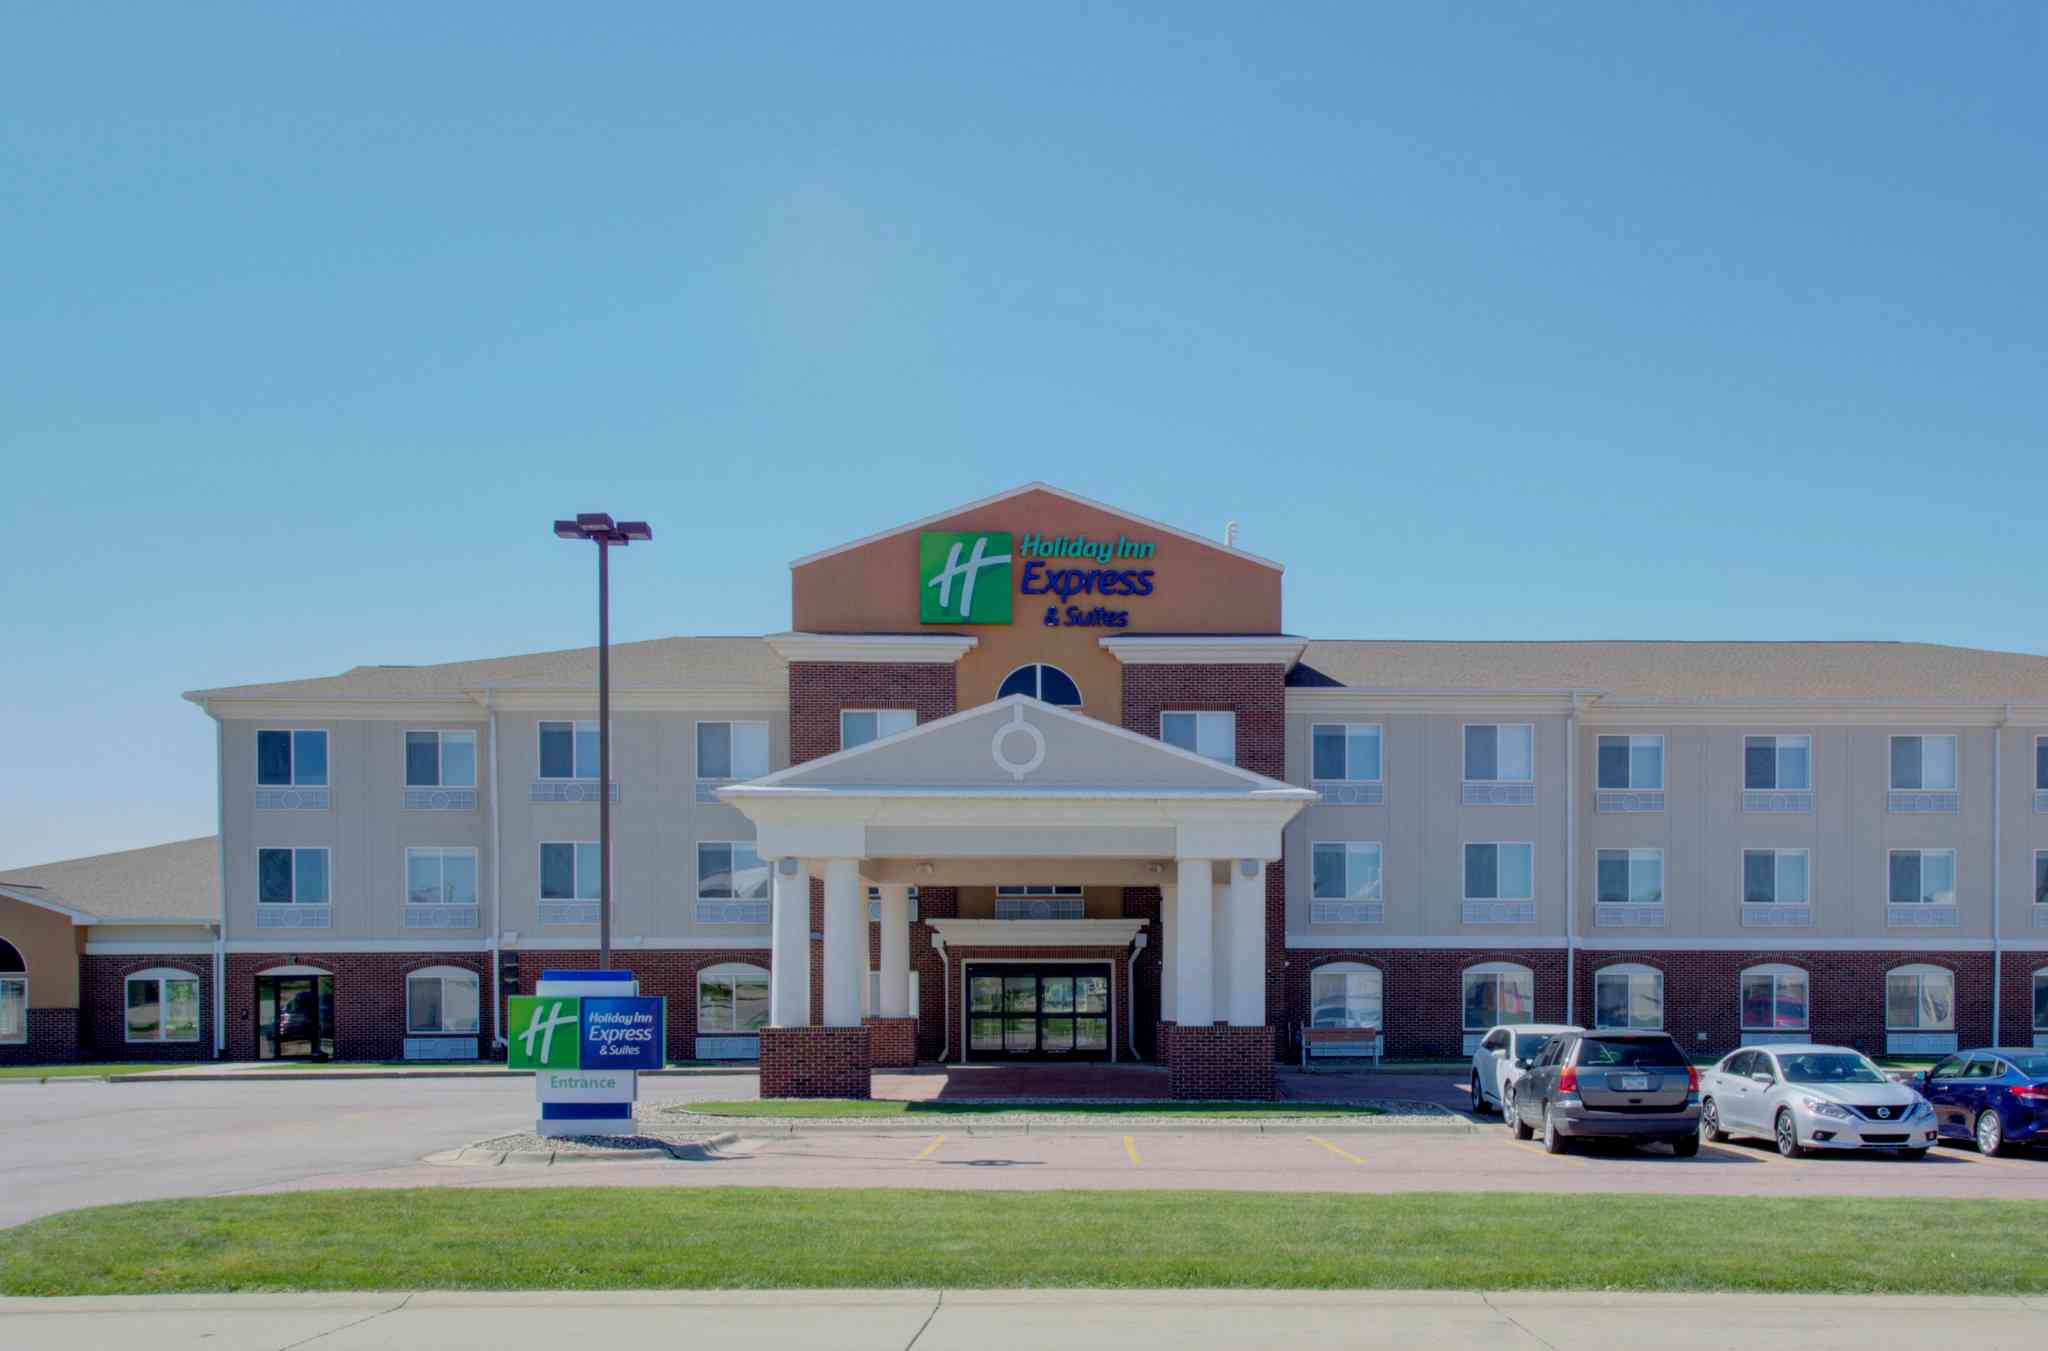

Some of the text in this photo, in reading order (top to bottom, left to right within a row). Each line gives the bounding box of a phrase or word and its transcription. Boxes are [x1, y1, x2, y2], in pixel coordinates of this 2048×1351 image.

[1020, 533, 1156, 564] Holiday Inn
[1020, 560, 1155, 603] Express
[1044, 606, 1129, 627] & Suites
[589, 1011, 653, 1025] Holiday Inn
[589, 1025, 655, 1045] Express
[599, 1045, 641, 1056] & Suites
[550, 1075, 617, 1089] Entrance
